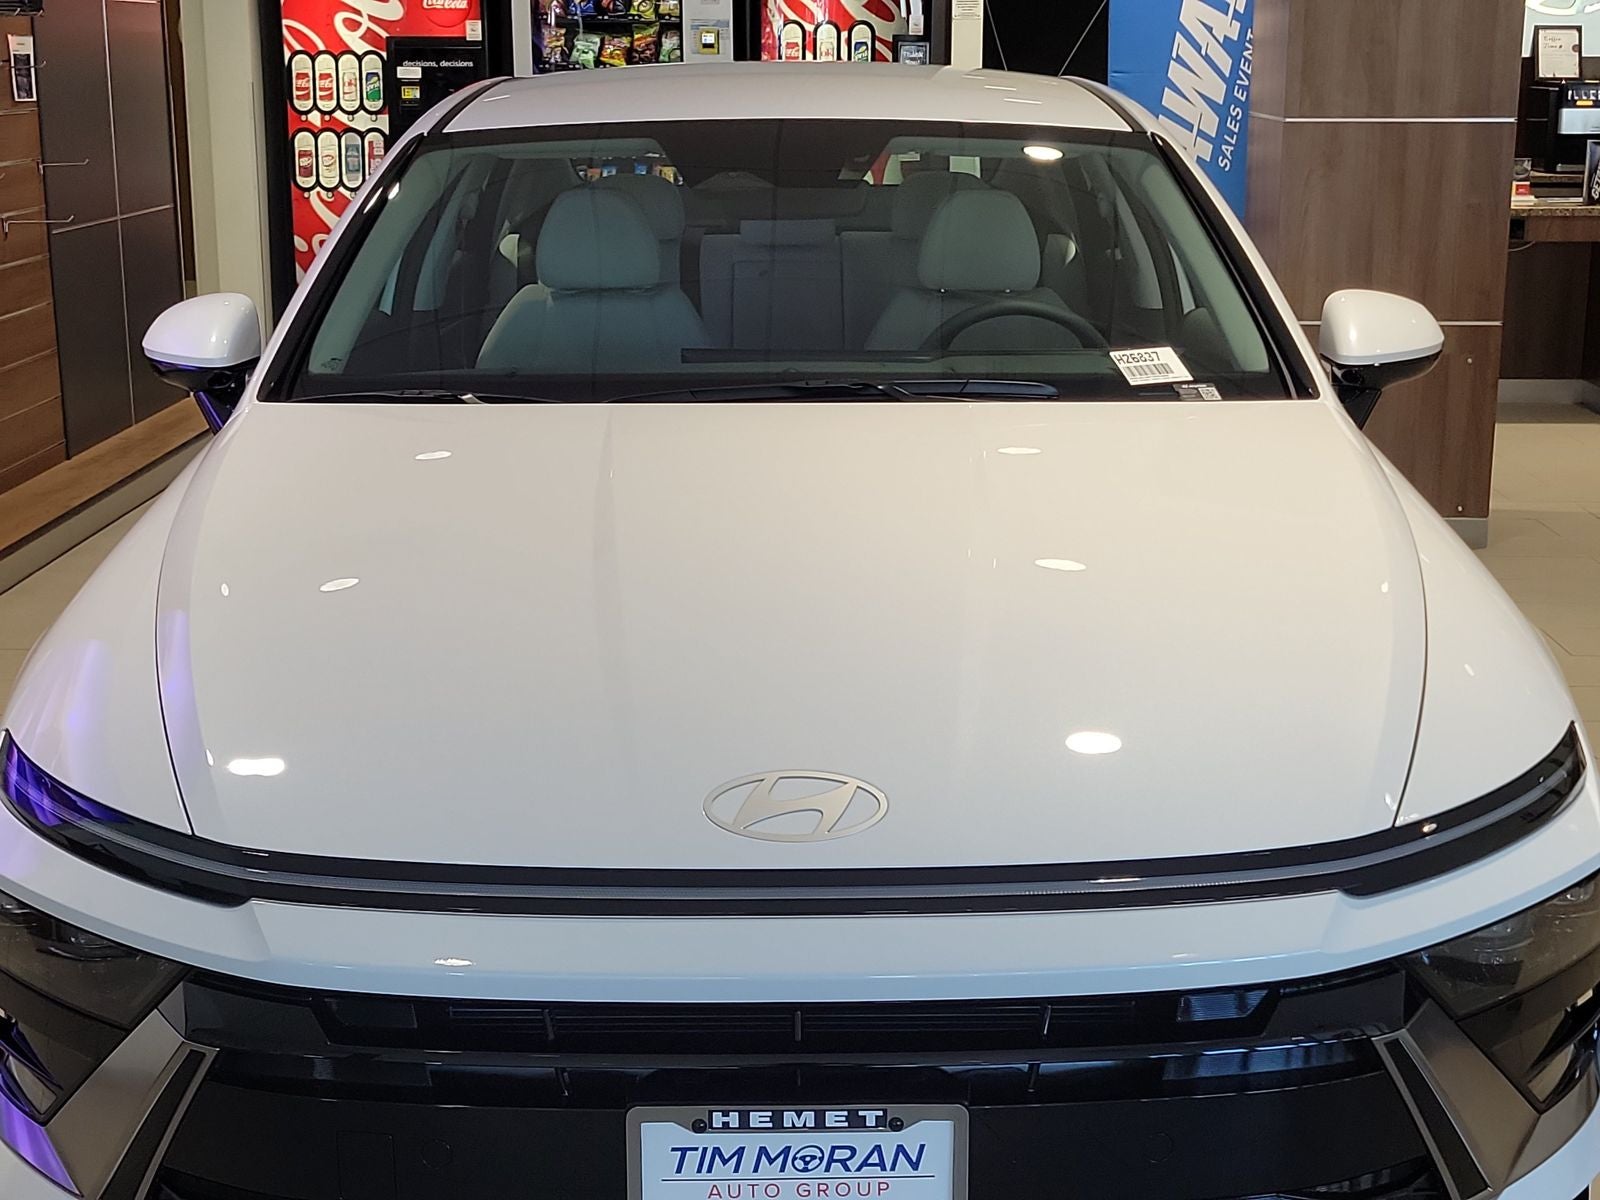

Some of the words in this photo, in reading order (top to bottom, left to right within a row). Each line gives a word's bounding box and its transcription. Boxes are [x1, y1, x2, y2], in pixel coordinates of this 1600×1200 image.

[402, 60, 438, 68] decisions,
[1218, 104, 1243, 172] SALES
[1113, 351, 1161, 365] H26837
[712, 1110, 884, 1129] HEMET
[670, 1146, 746, 1174] TIM
[752, 1143, 926, 1174] MORAN
[708, 1184, 781, 1199] AUTO
[796, 1181, 890, 1198] GROUP
